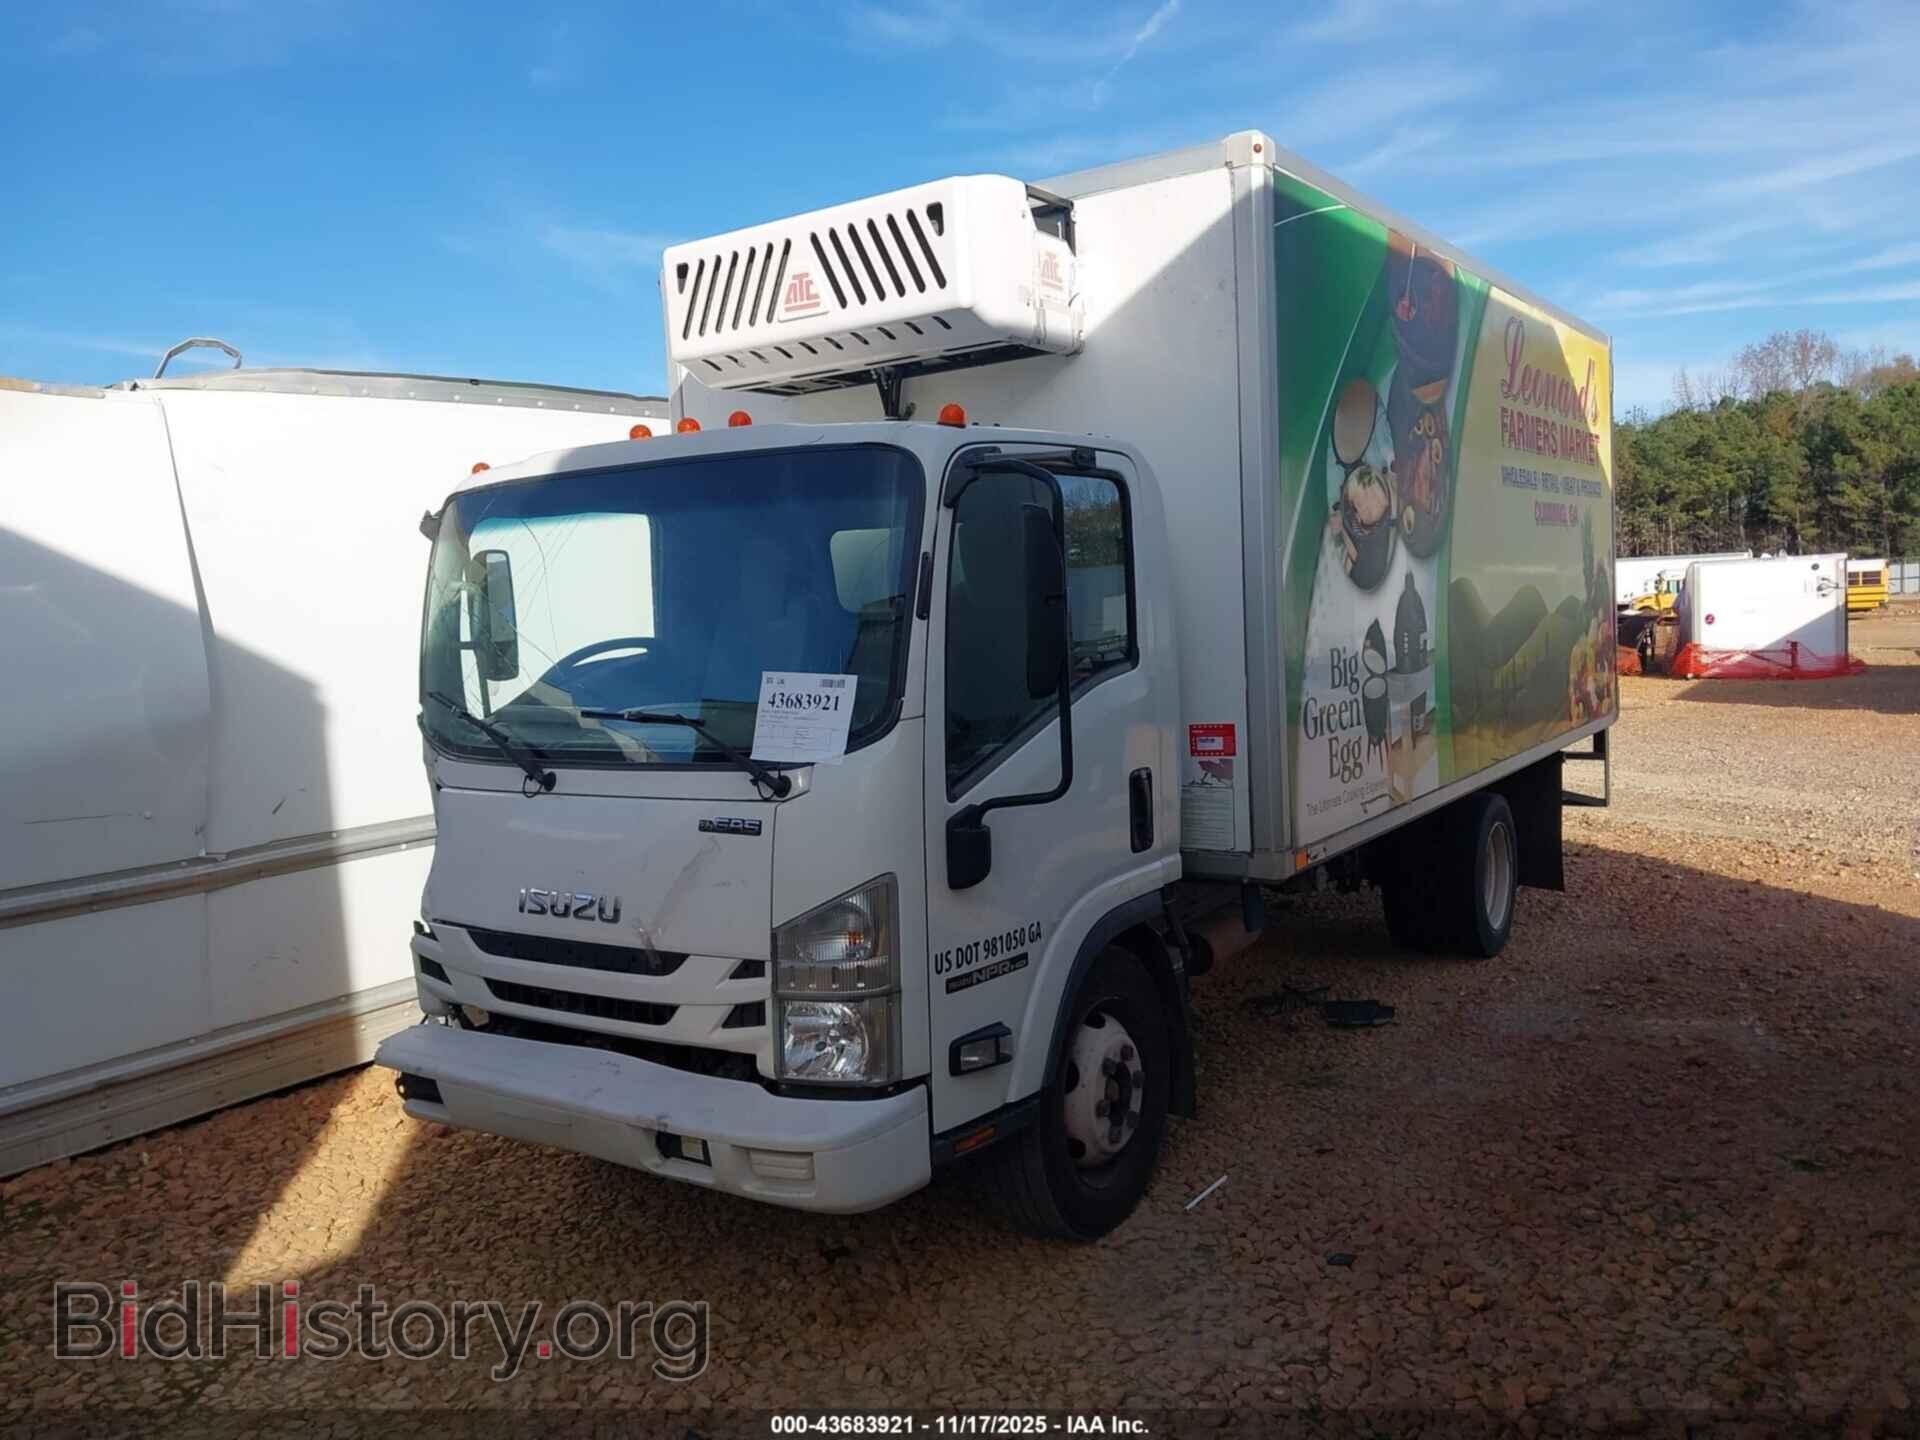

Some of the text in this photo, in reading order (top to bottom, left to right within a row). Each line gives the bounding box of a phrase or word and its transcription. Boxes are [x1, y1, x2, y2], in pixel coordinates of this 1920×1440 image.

[784, 272, 821, 304] ATC
[1500, 406, 1601, 467] FARMERS MARKET
[1330, 645, 1360, 695] Big
[768, 691, 840, 711] 43683921
[1303, 697, 1362, 740] Green
[1328, 735, 1363, 784] Egg
[518, 887, 622, 924] ISUZU
[934, 921, 1042, 975] US DOT 981050 GA
